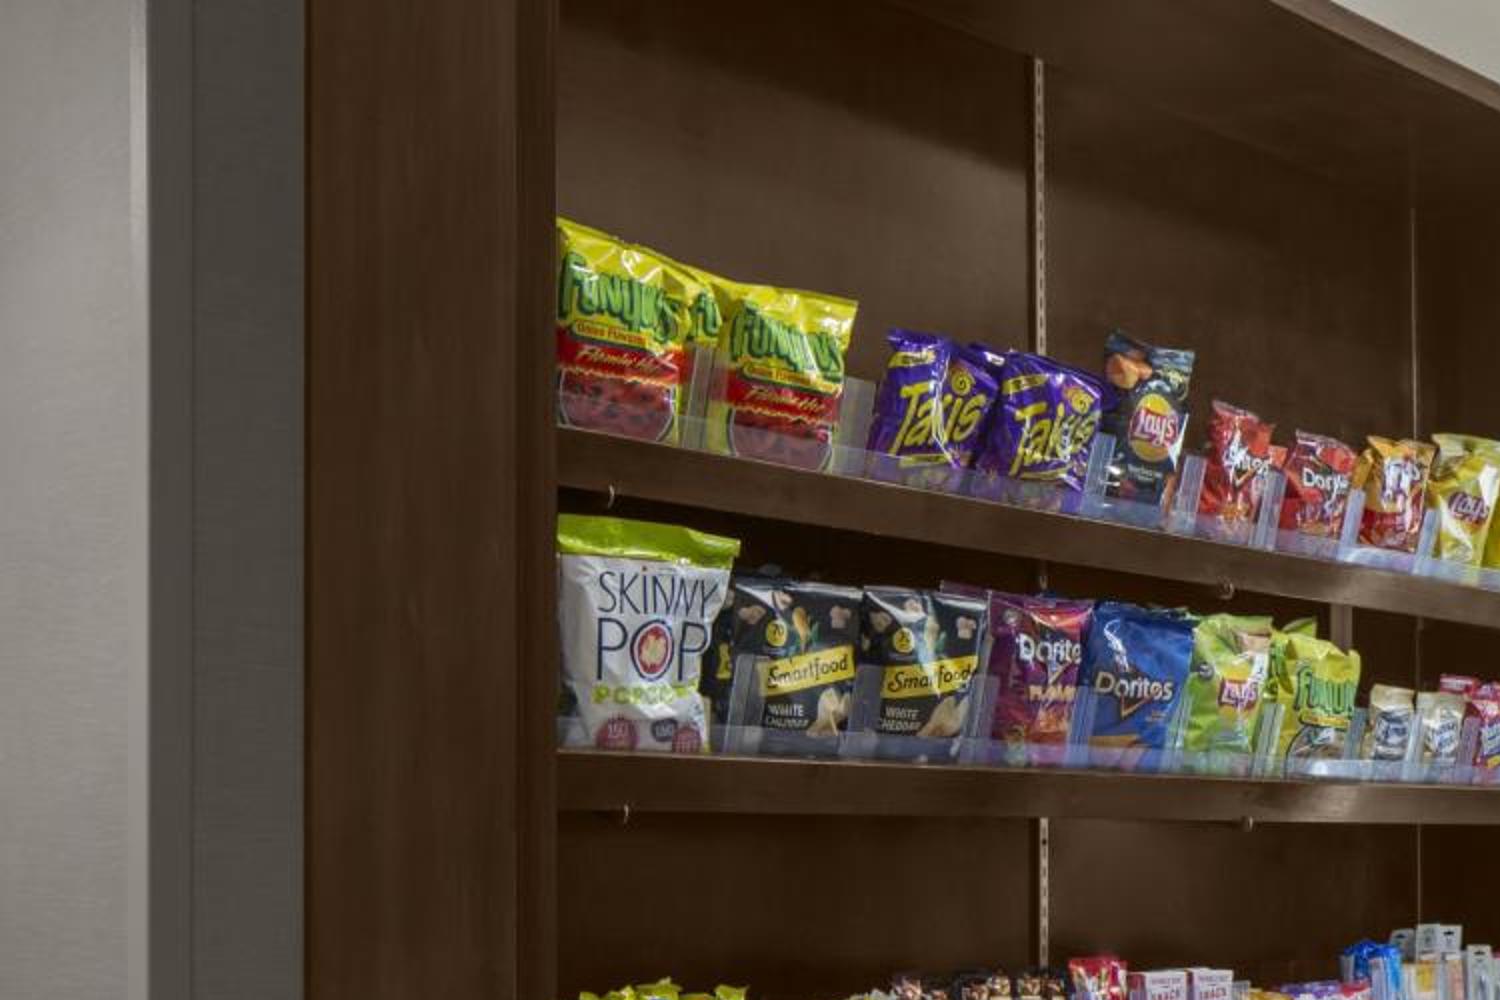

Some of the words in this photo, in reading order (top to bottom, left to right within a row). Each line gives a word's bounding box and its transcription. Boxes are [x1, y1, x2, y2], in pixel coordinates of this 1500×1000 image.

[597, 617, 710, 682] POP
[1016, 633, 1082, 665] Dorito
[767, 654, 848, 689] Smartfood
[887, 663, 976, 692] Smafood
[1094, 671, 1174, 701] Doritos
